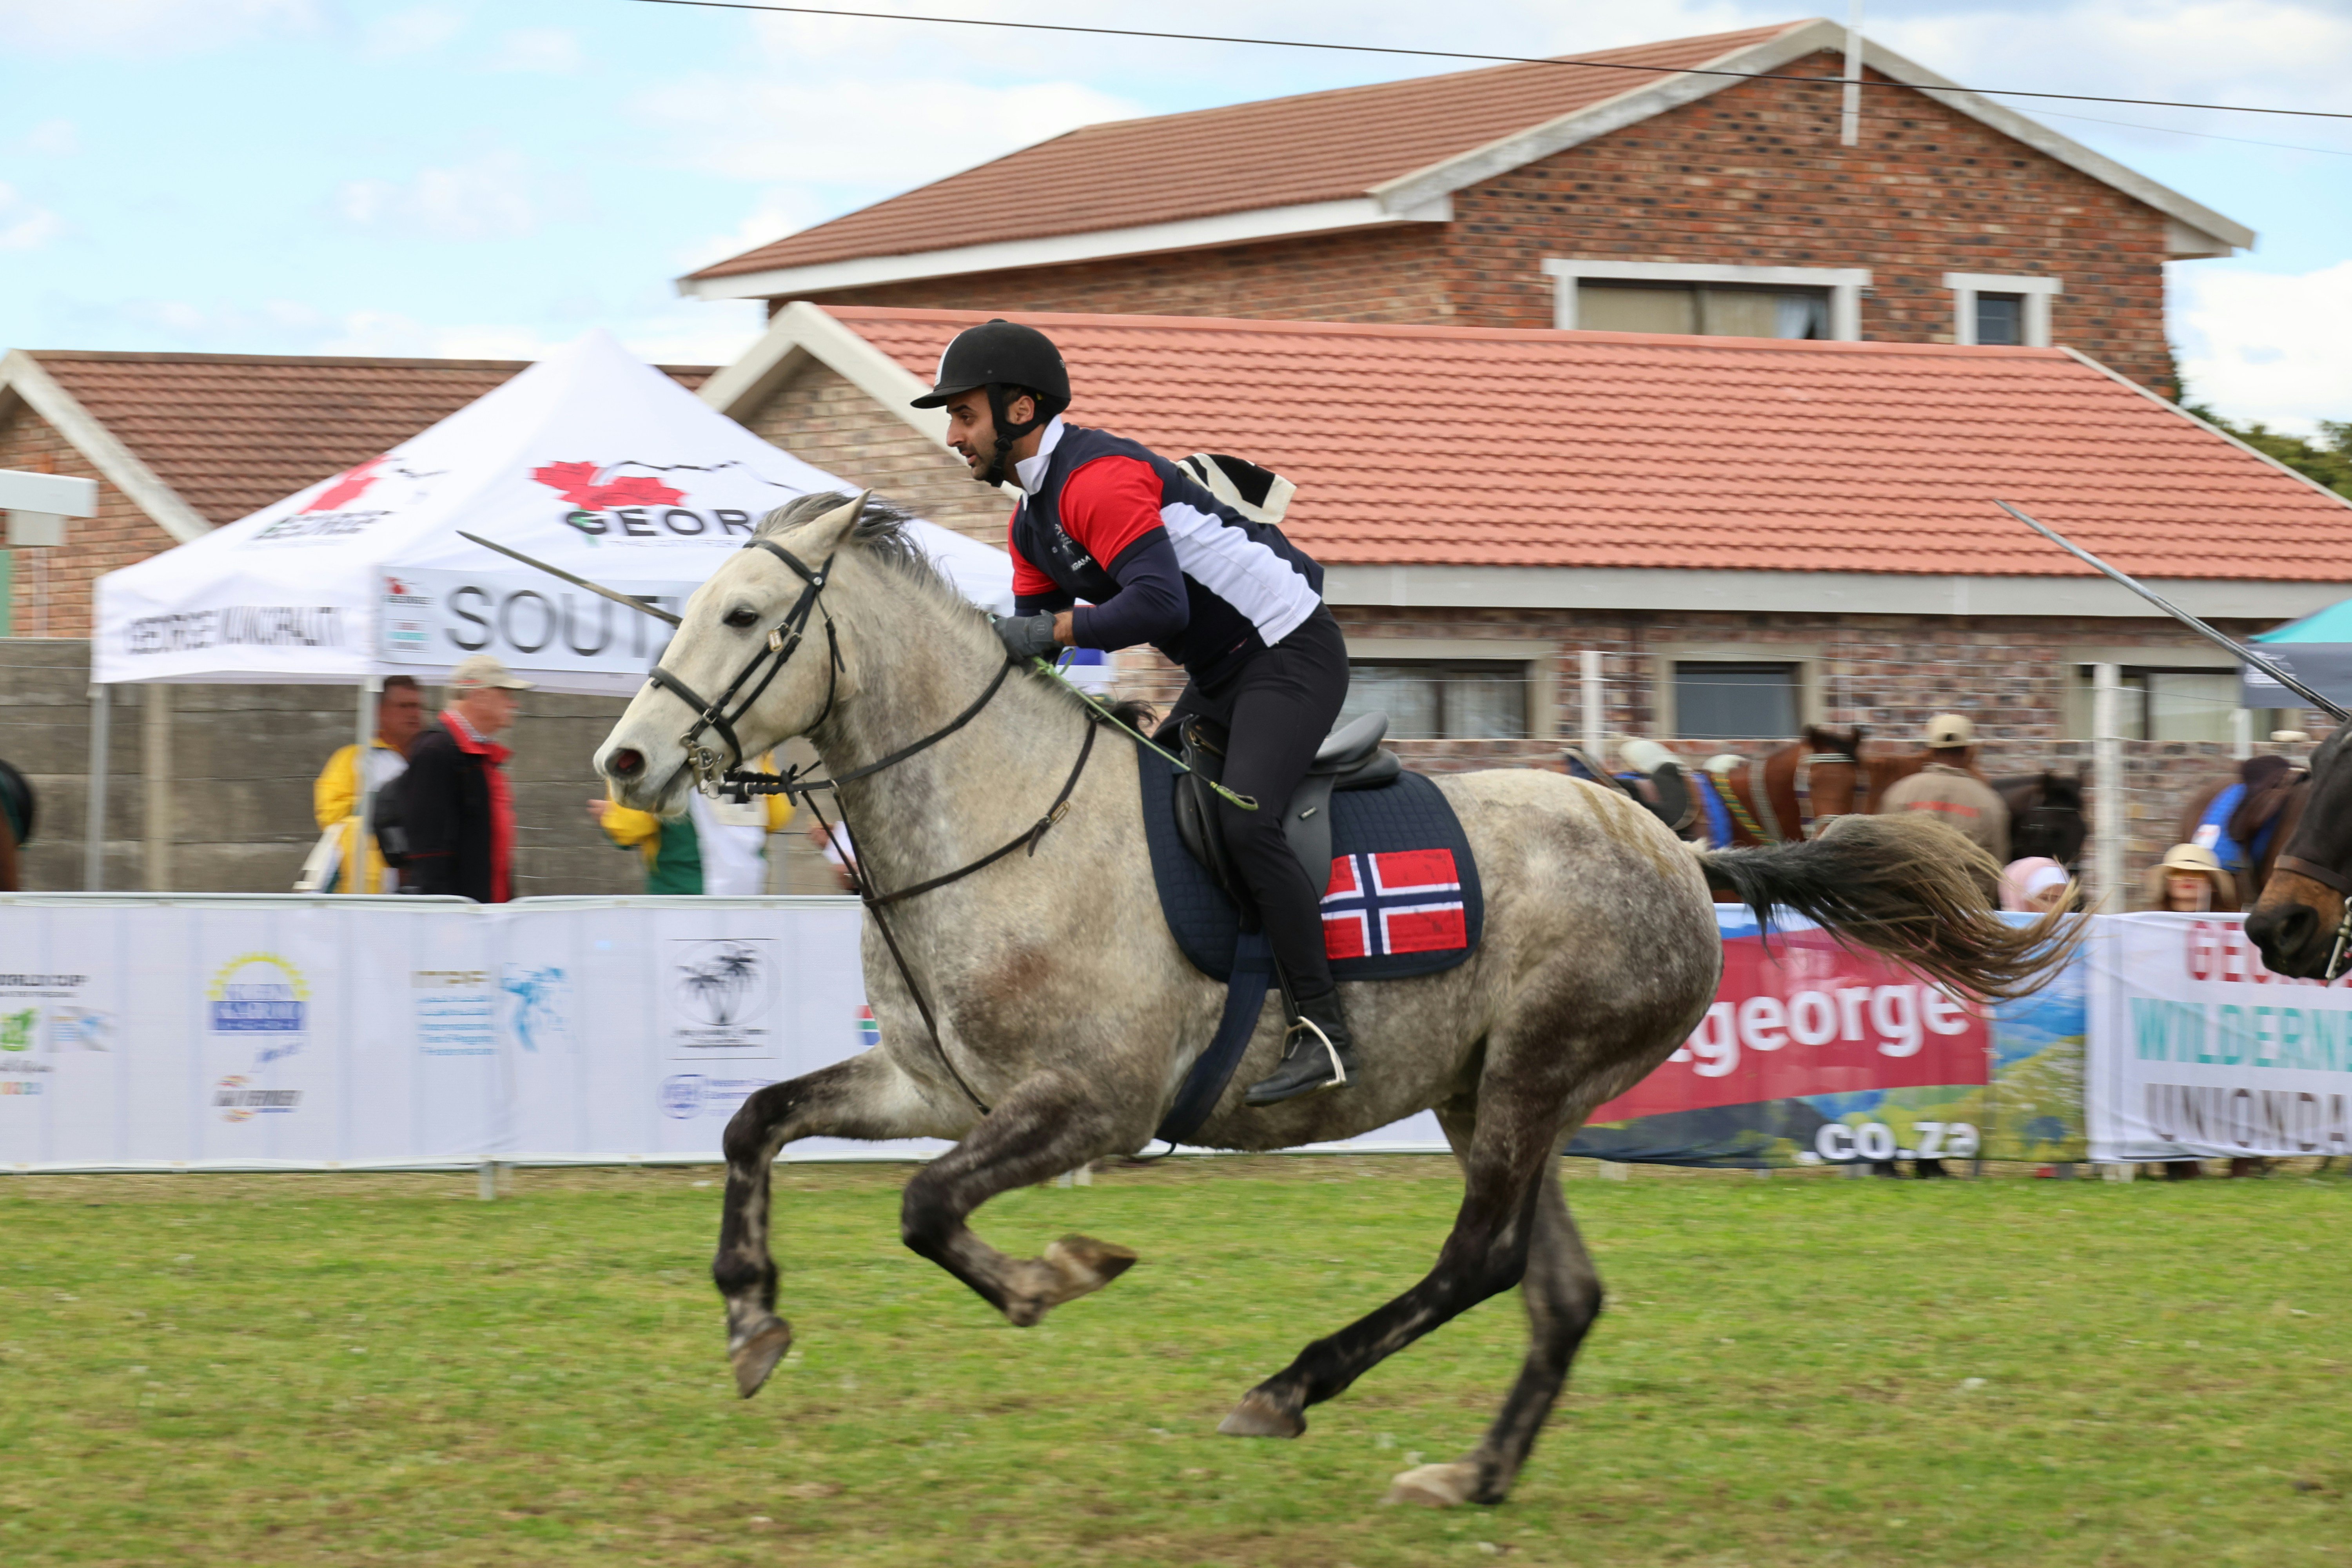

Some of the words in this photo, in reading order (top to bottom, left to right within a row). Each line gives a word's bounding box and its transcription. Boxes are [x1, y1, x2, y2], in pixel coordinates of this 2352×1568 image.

[564, 509, 762, 535] GEOR
[1666, 981, 1970, 1077] george
[2129, 997, 2352, 1072] WILDERN
